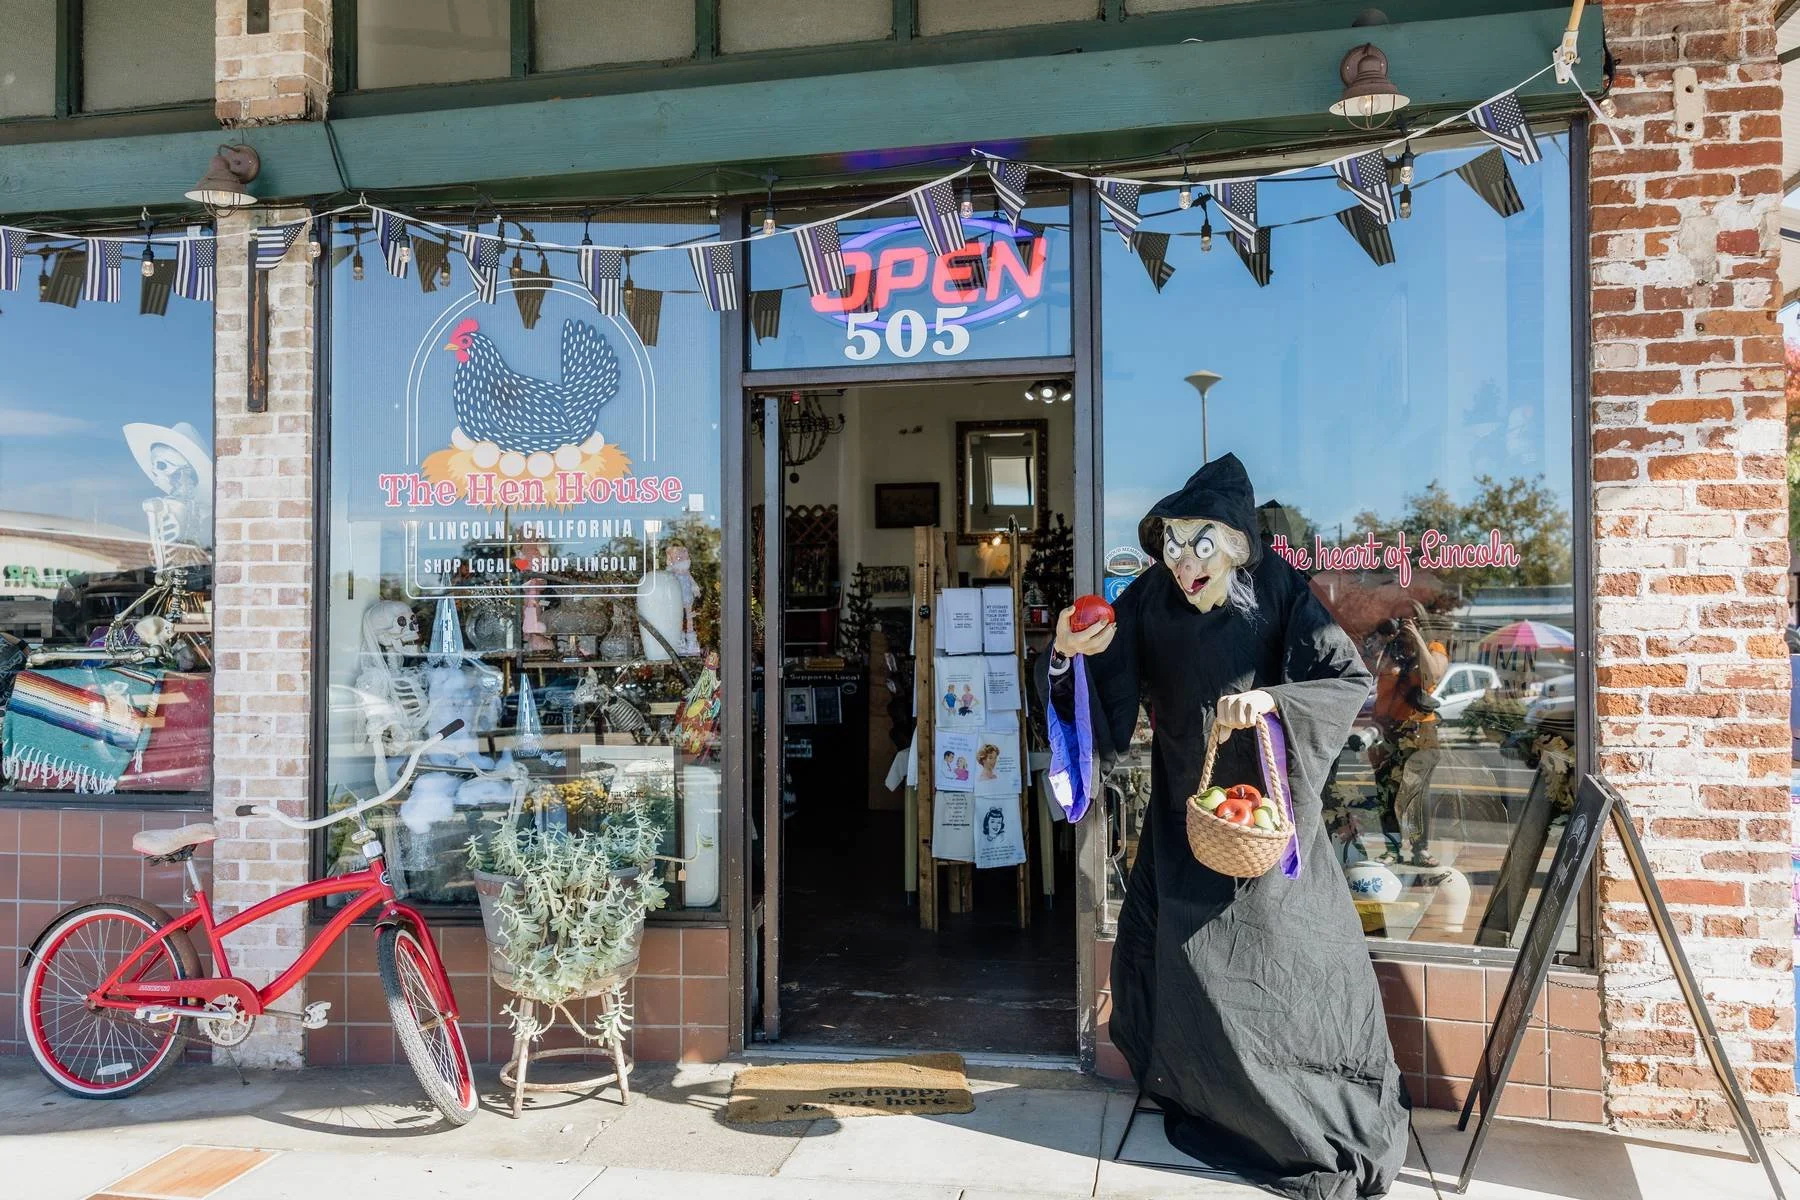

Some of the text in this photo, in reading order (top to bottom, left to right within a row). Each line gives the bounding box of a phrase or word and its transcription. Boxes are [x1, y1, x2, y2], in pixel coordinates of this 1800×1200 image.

[811, 235, 1047, 313] OPEN
[844, 306, 970, 360] 505
[379, 471, 683, 507] The Hen House
[428, 519, 633, 542] LINCOLN, CALIFORNIA
[424, 556, 637, 574] SHOP LOCAL SHOP LINCOLN
[1315, 532, 1384, 571] heart
[1384, 531, 1413, 588] of
[1419, 528, 1520, 569] Lincoln
[867, 1088, 948, 1099] happy
